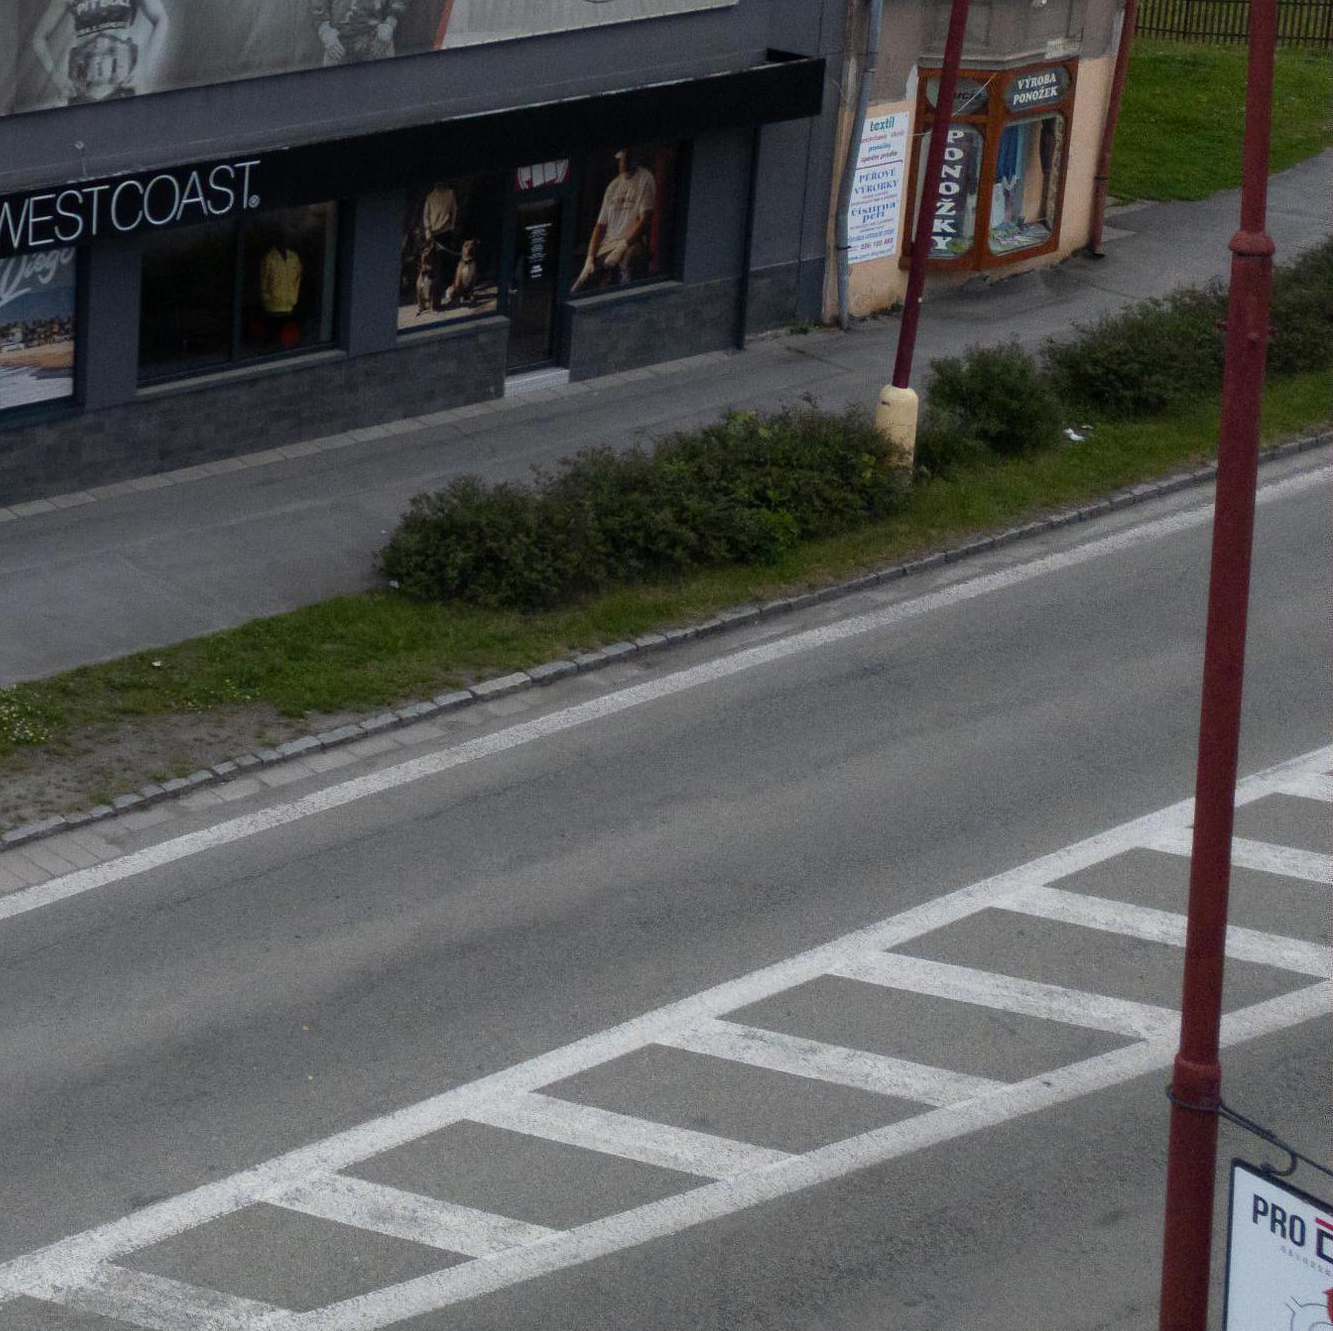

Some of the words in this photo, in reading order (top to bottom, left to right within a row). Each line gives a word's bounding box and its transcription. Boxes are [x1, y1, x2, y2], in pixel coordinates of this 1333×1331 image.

[1016, 71, 1057, 90] VÝROBA
[1012, 84, 1059, 106] PONOŽEK
[869, 116, 896, 132] textil
[930, 129, 965, 251] PONOŽKY
[1252, 1192, 1307, 1248] PRO
